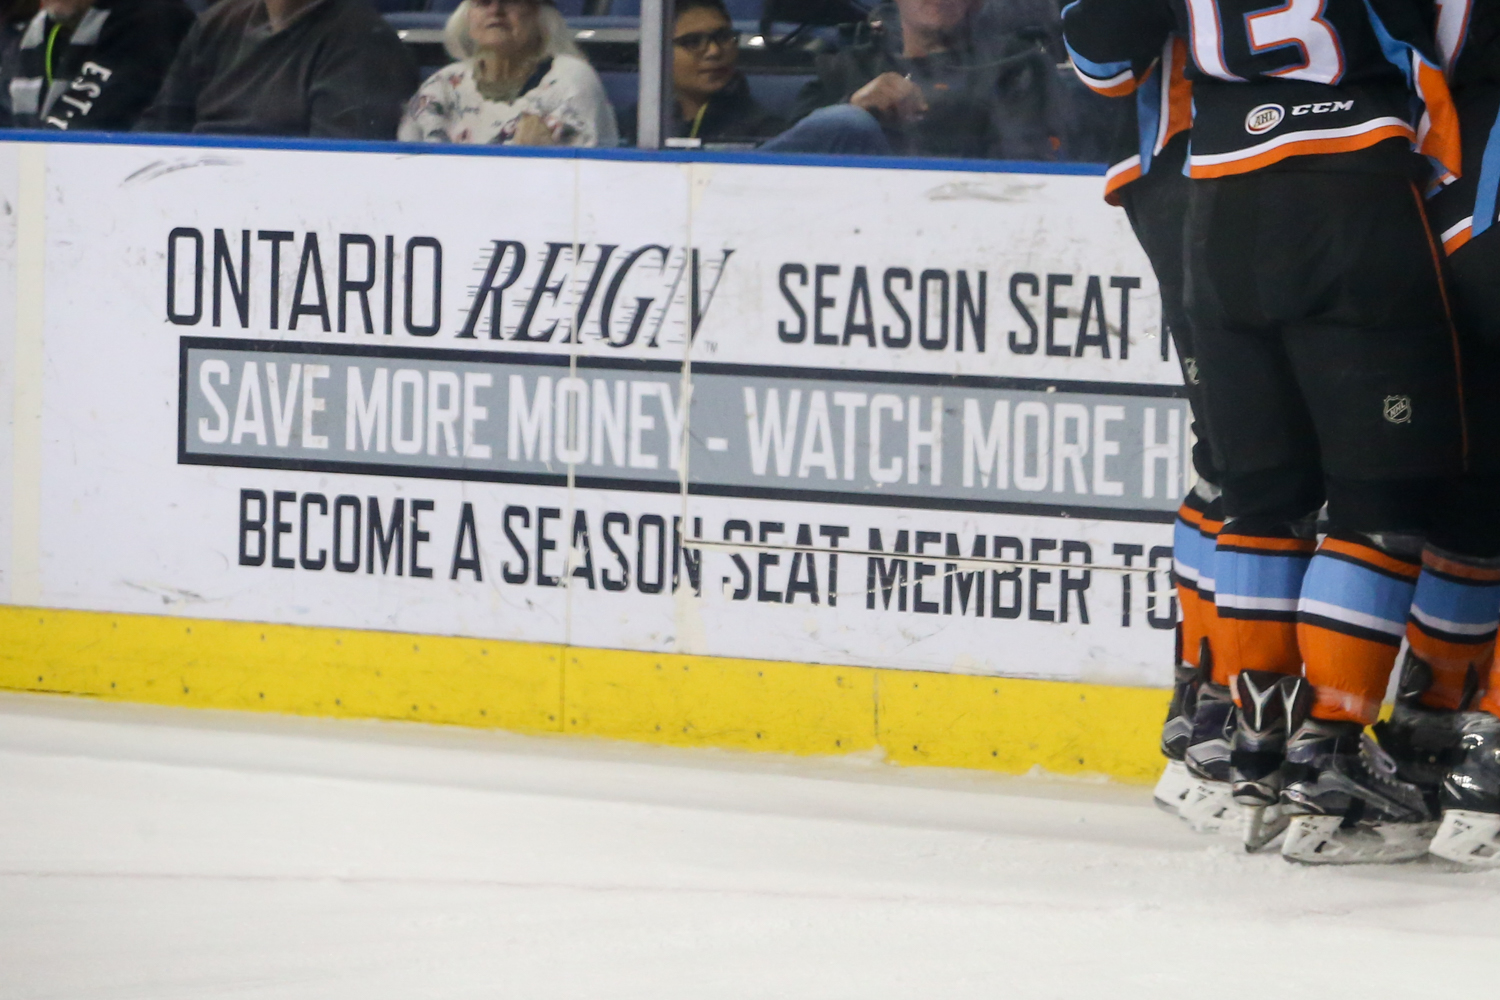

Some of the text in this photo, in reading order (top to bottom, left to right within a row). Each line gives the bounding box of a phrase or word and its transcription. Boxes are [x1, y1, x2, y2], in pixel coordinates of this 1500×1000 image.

[1252, 110, 1277, 129] AHL
[1291, 99, 1355, 117] CCM
[167, 226, 443, 337] ONTARIO
[455, 239, 735, 349] REIGN
[778, 262, 988, 353] SEASON
[1008, 271, 1142, 361] SEAT
[198, 359, 330, 450] SAVE
[344, 366, 493, 459] MORE
[507, 374, 694, 470] MONEY
[743, 386, 943, 487] WATCH
[962, 398, 1124, 497] MORE
[1142, 406, 1185, 500] H
[238, 488, 435, 579] BECOME
[451, 501, 483, 582] A
[503, 505, 702, 599] SEASON
[722, 518, 849, 608] SEAT
[866, 527, 1092, 625] MEMBER
